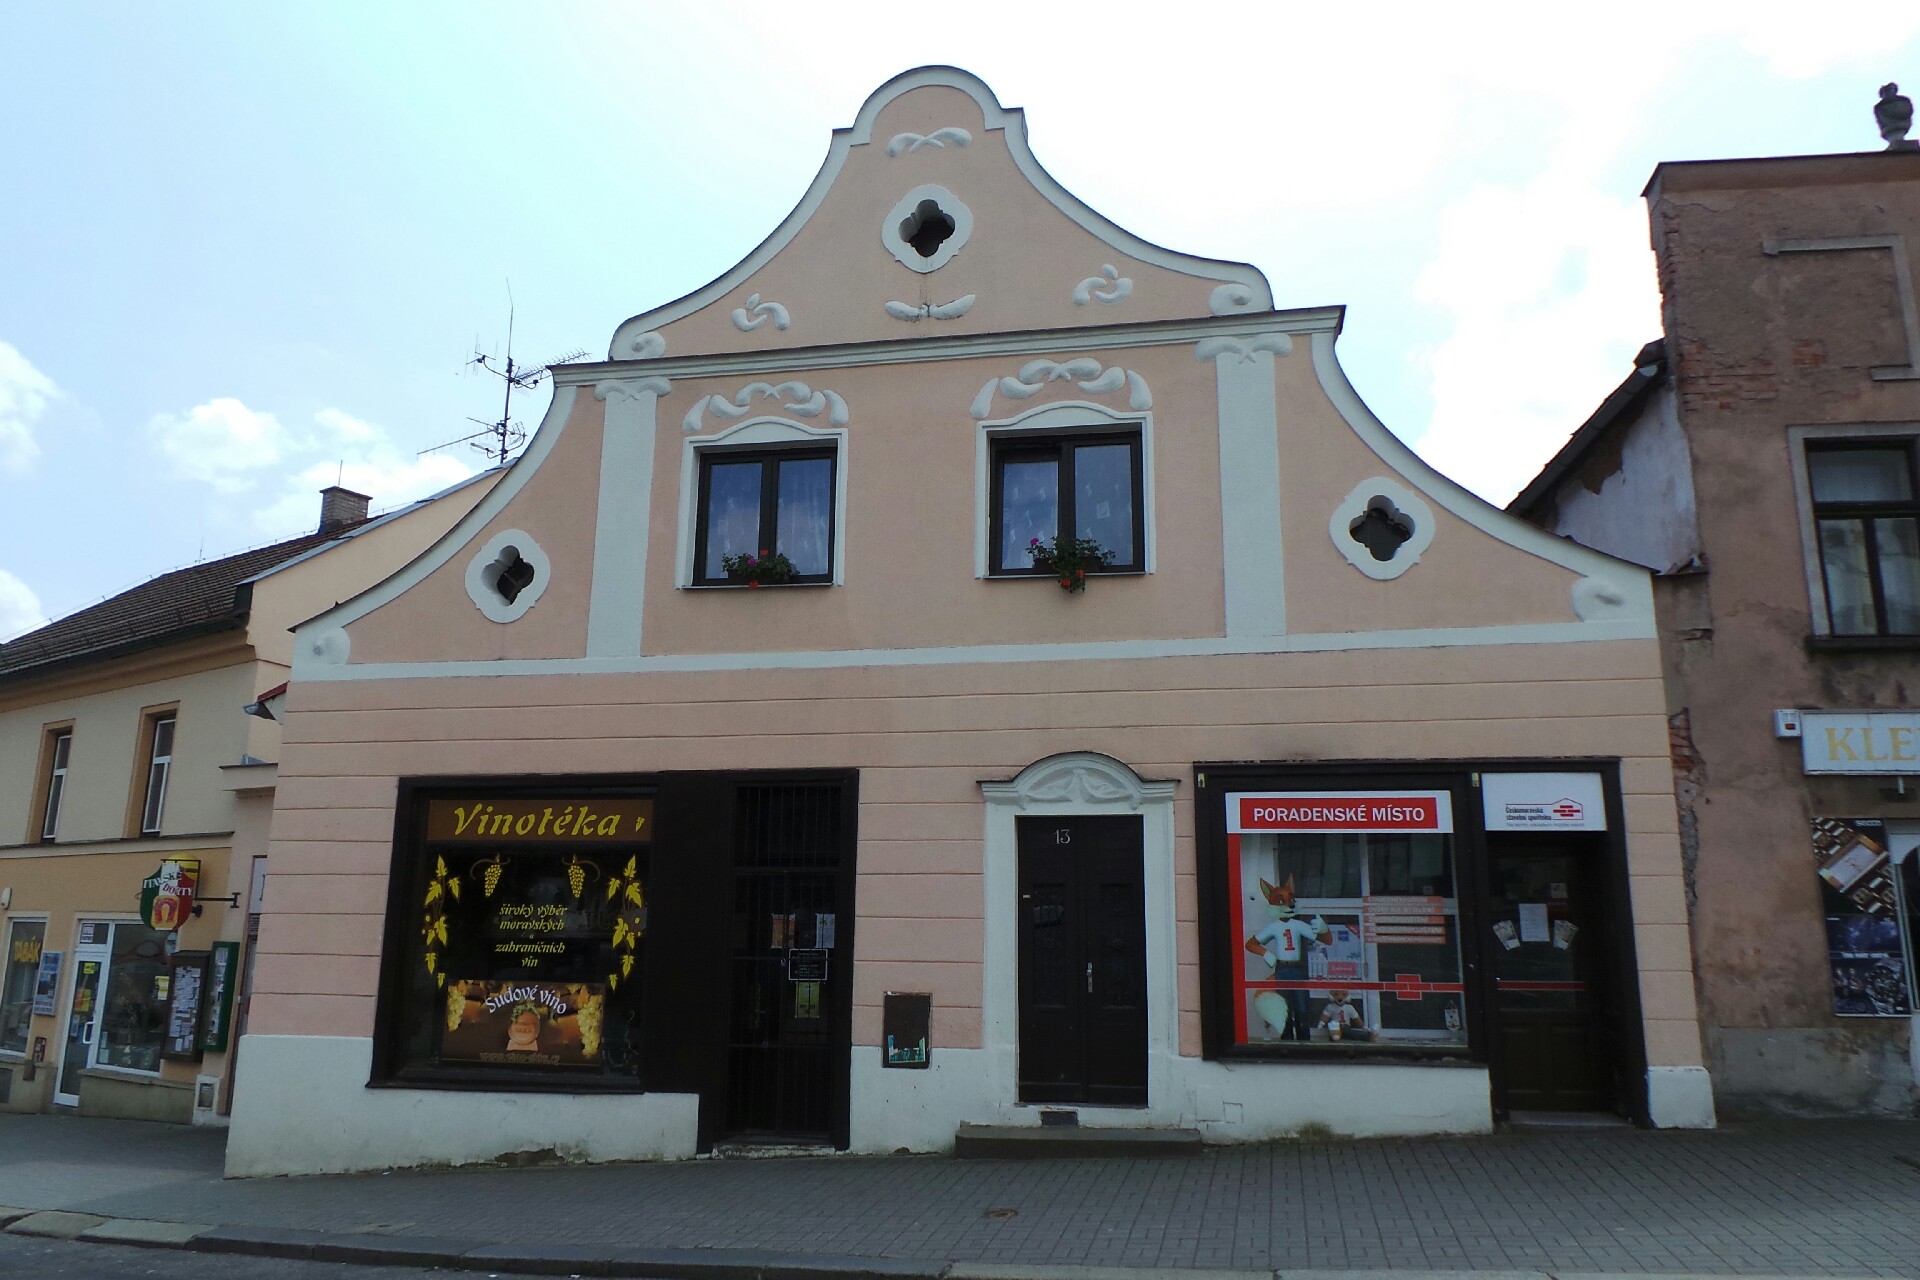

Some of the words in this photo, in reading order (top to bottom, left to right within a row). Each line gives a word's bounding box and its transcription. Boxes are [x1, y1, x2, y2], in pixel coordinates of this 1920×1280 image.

[1824, 727, 1920, 761] KLE
[454, 803, 621, 836] Vinotéka
[1253, 804, 1368, 822] PORADENSKÉ
[1372, 804, 1426, 822] MÍSTO
[1053, 829, 1071, 845] 13
[162, 883, 193, 896] DORTY
[498, 903, 534, 918] široký
[537, 903, 568, 918] výběr
[499, 919, 564, 932] moravských
[485, 984, 539, 1014] Sudové
[539, 989, 567, 1015] víno
